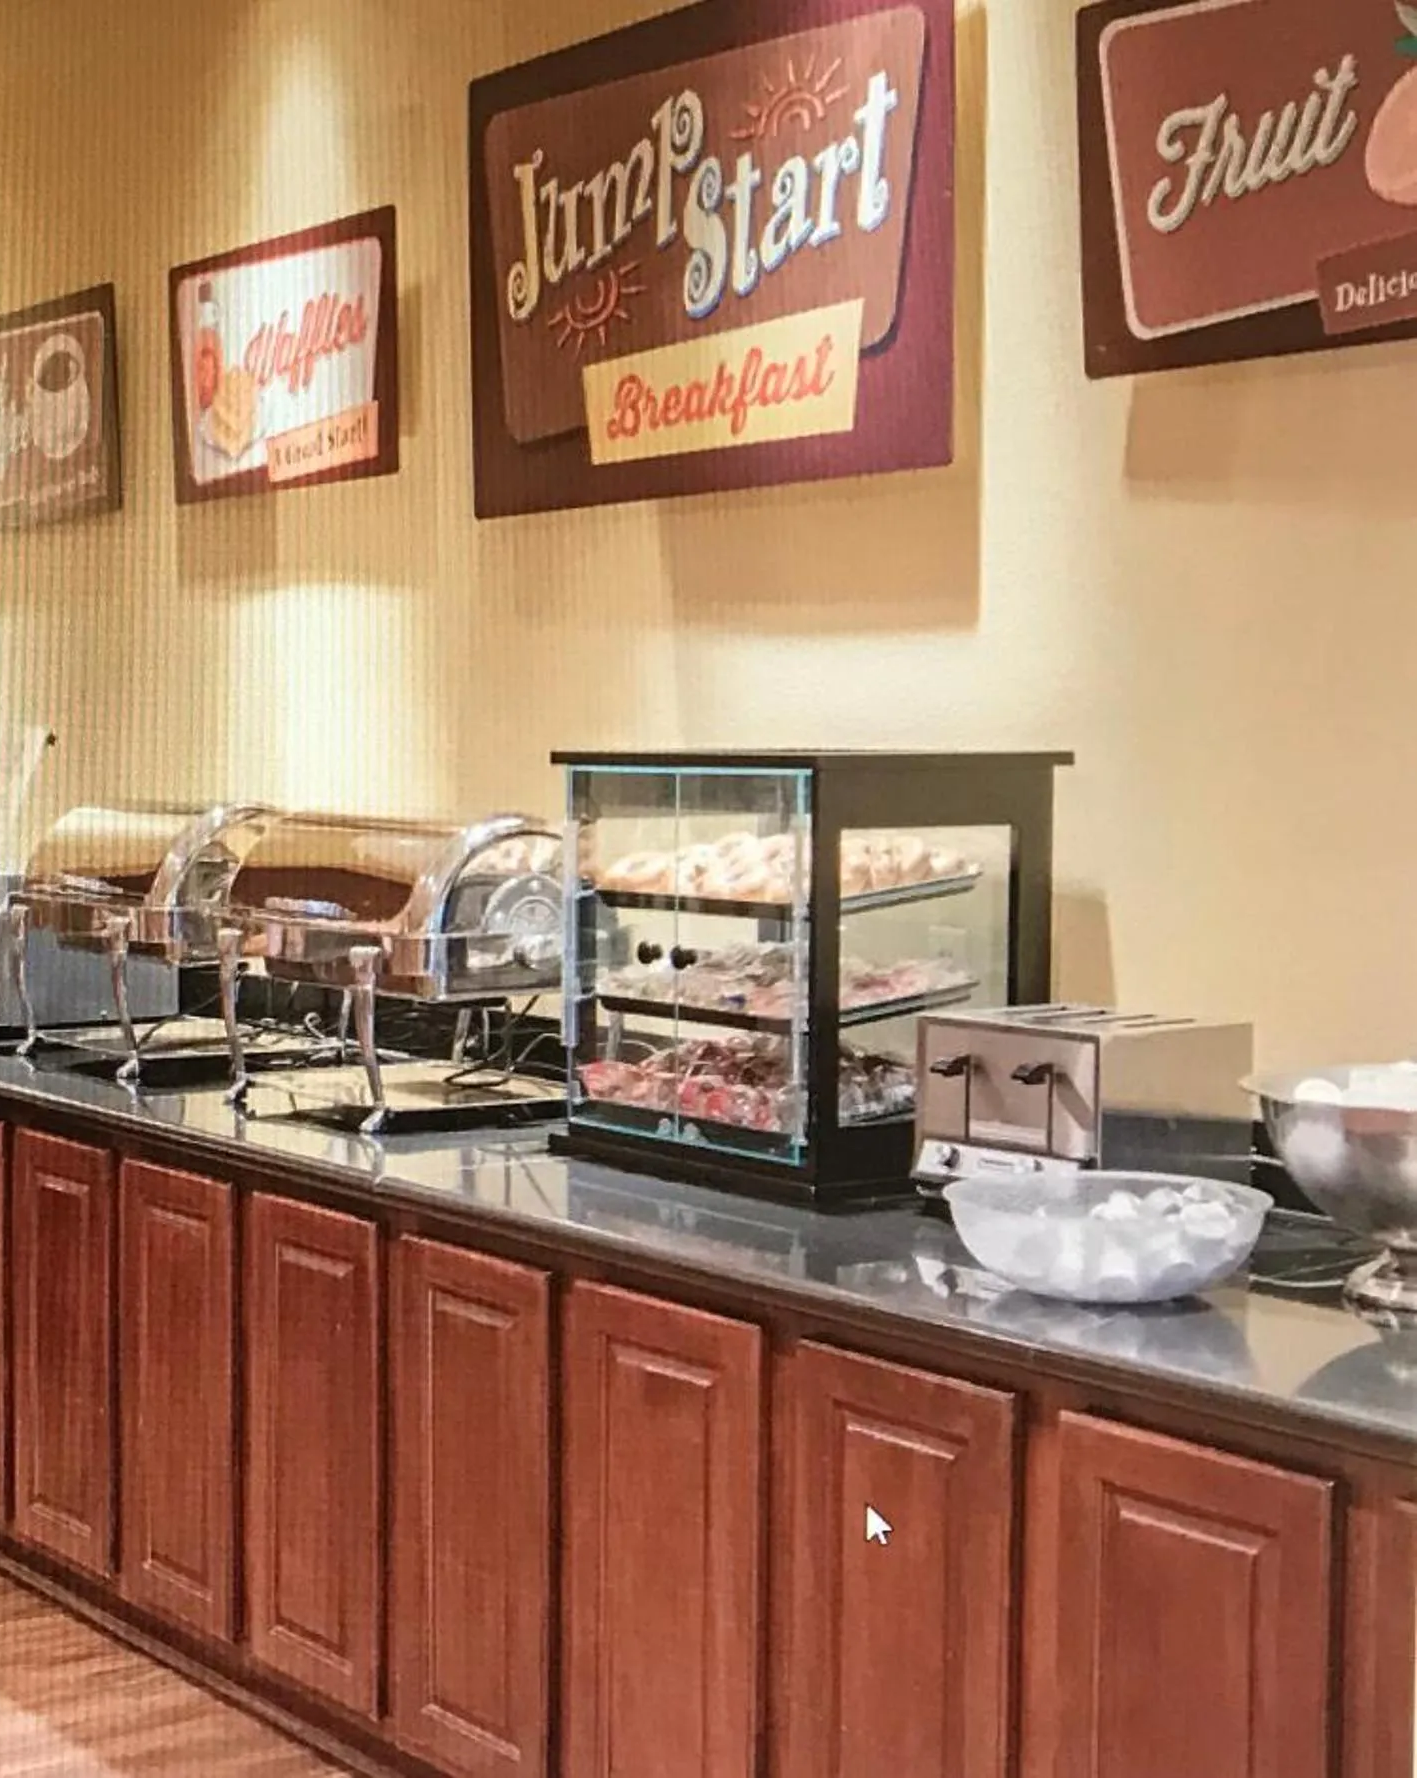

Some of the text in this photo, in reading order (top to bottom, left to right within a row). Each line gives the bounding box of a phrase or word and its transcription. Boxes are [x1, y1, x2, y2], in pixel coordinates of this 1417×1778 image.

[507, 69, 898, 324] Jump Start
[1147, 54, 1360, 234] Fruit
[243, 292, 368, 396] Waffles
[605, 333, 836, 442] Breakfast
